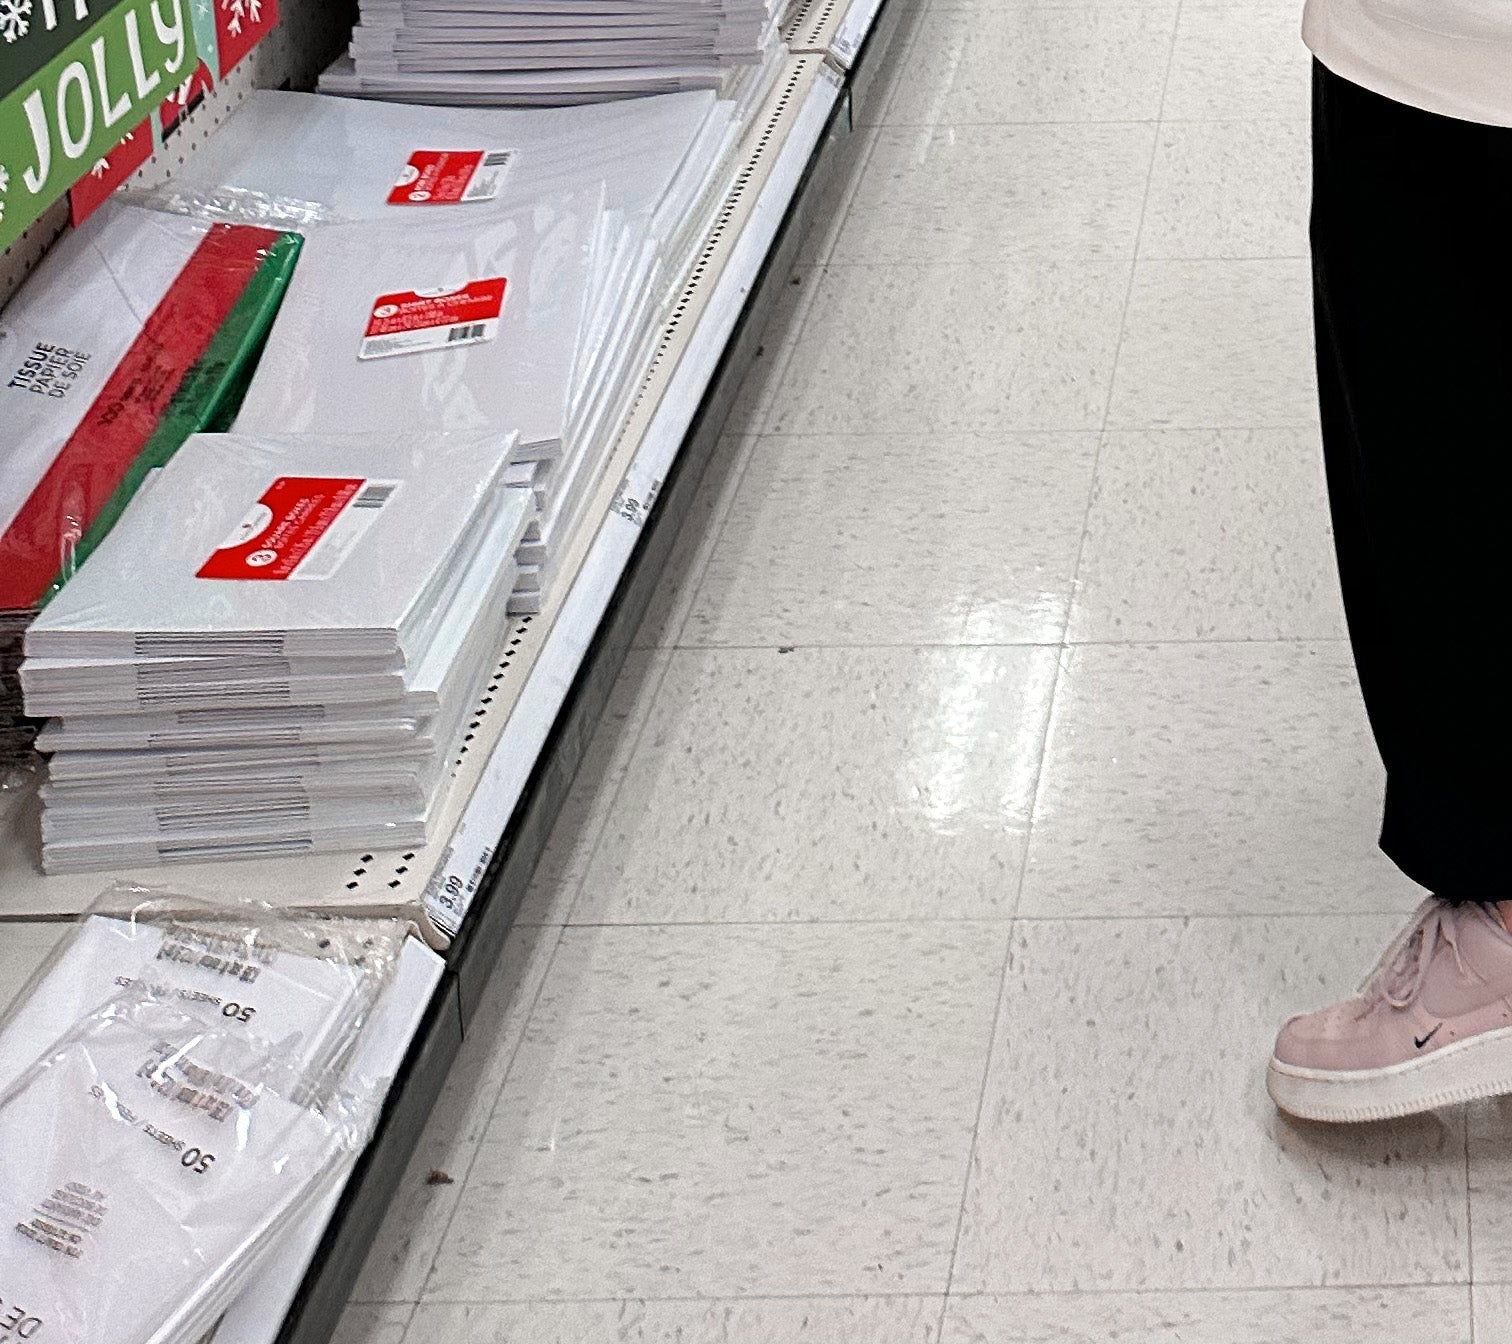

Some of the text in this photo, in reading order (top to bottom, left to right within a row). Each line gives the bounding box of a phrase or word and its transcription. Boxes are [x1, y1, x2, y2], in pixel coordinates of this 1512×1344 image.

[8, 341, 55, 389] TISSUE
[29, 347, 75, 395] PAPIER
[48, 351, 92, 399] DE SOIE
[439, 875, 463, 909] 3.99
[222, 1002, 257, 1023] 50
[181, 1147, 216, 1174] 50
